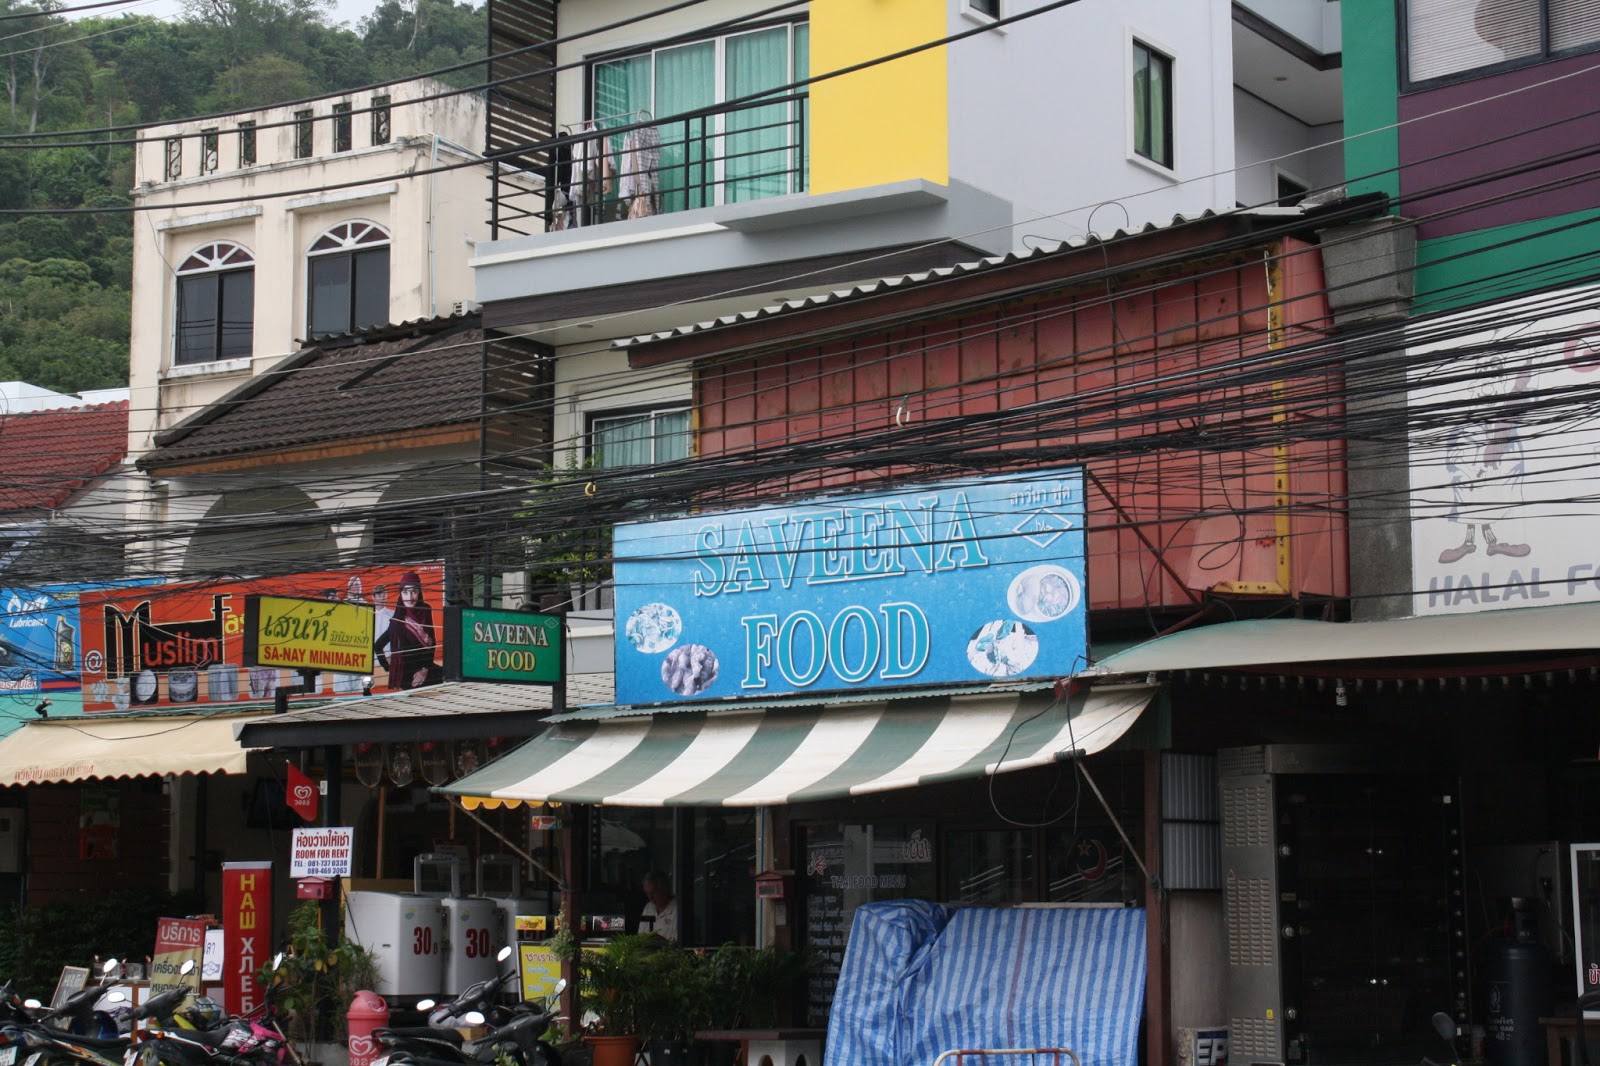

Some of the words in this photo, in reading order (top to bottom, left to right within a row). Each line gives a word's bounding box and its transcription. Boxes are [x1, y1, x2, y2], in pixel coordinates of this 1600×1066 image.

[694, 491, 988, 597] SAVEENA
[1429, 567, 1550, 608] HALAL
[1567, 563, 1600, 596] F
[474, 621, 549, 647] SAVEENA
[741, 601, 930, 690] FOOD
[264, 645, 306, 662] SA-NAY
[310, 649, 367, 668] MINIMART
[487, 648, 536, 672] FOOD
[296, 830, 350, 848] ห้องว่างให้เช่า
[295, 849, 316, 859] ROOM
[317, 849, 330, 859] FOR
[331, 848, 350, 859] RENT
[830, 875, 851, 889] THAI
[853, 875, 878, 888] FOOD
[879, 874, 907, 888] MENU
[240, 874, 256, 930] НАШ
[161, 921, 201, 943] บริการ
[413, 926, 432, 955] 30
[466, 928, 490, 958] 30
[239, 937, 255, 1014] ХЛЕБ
